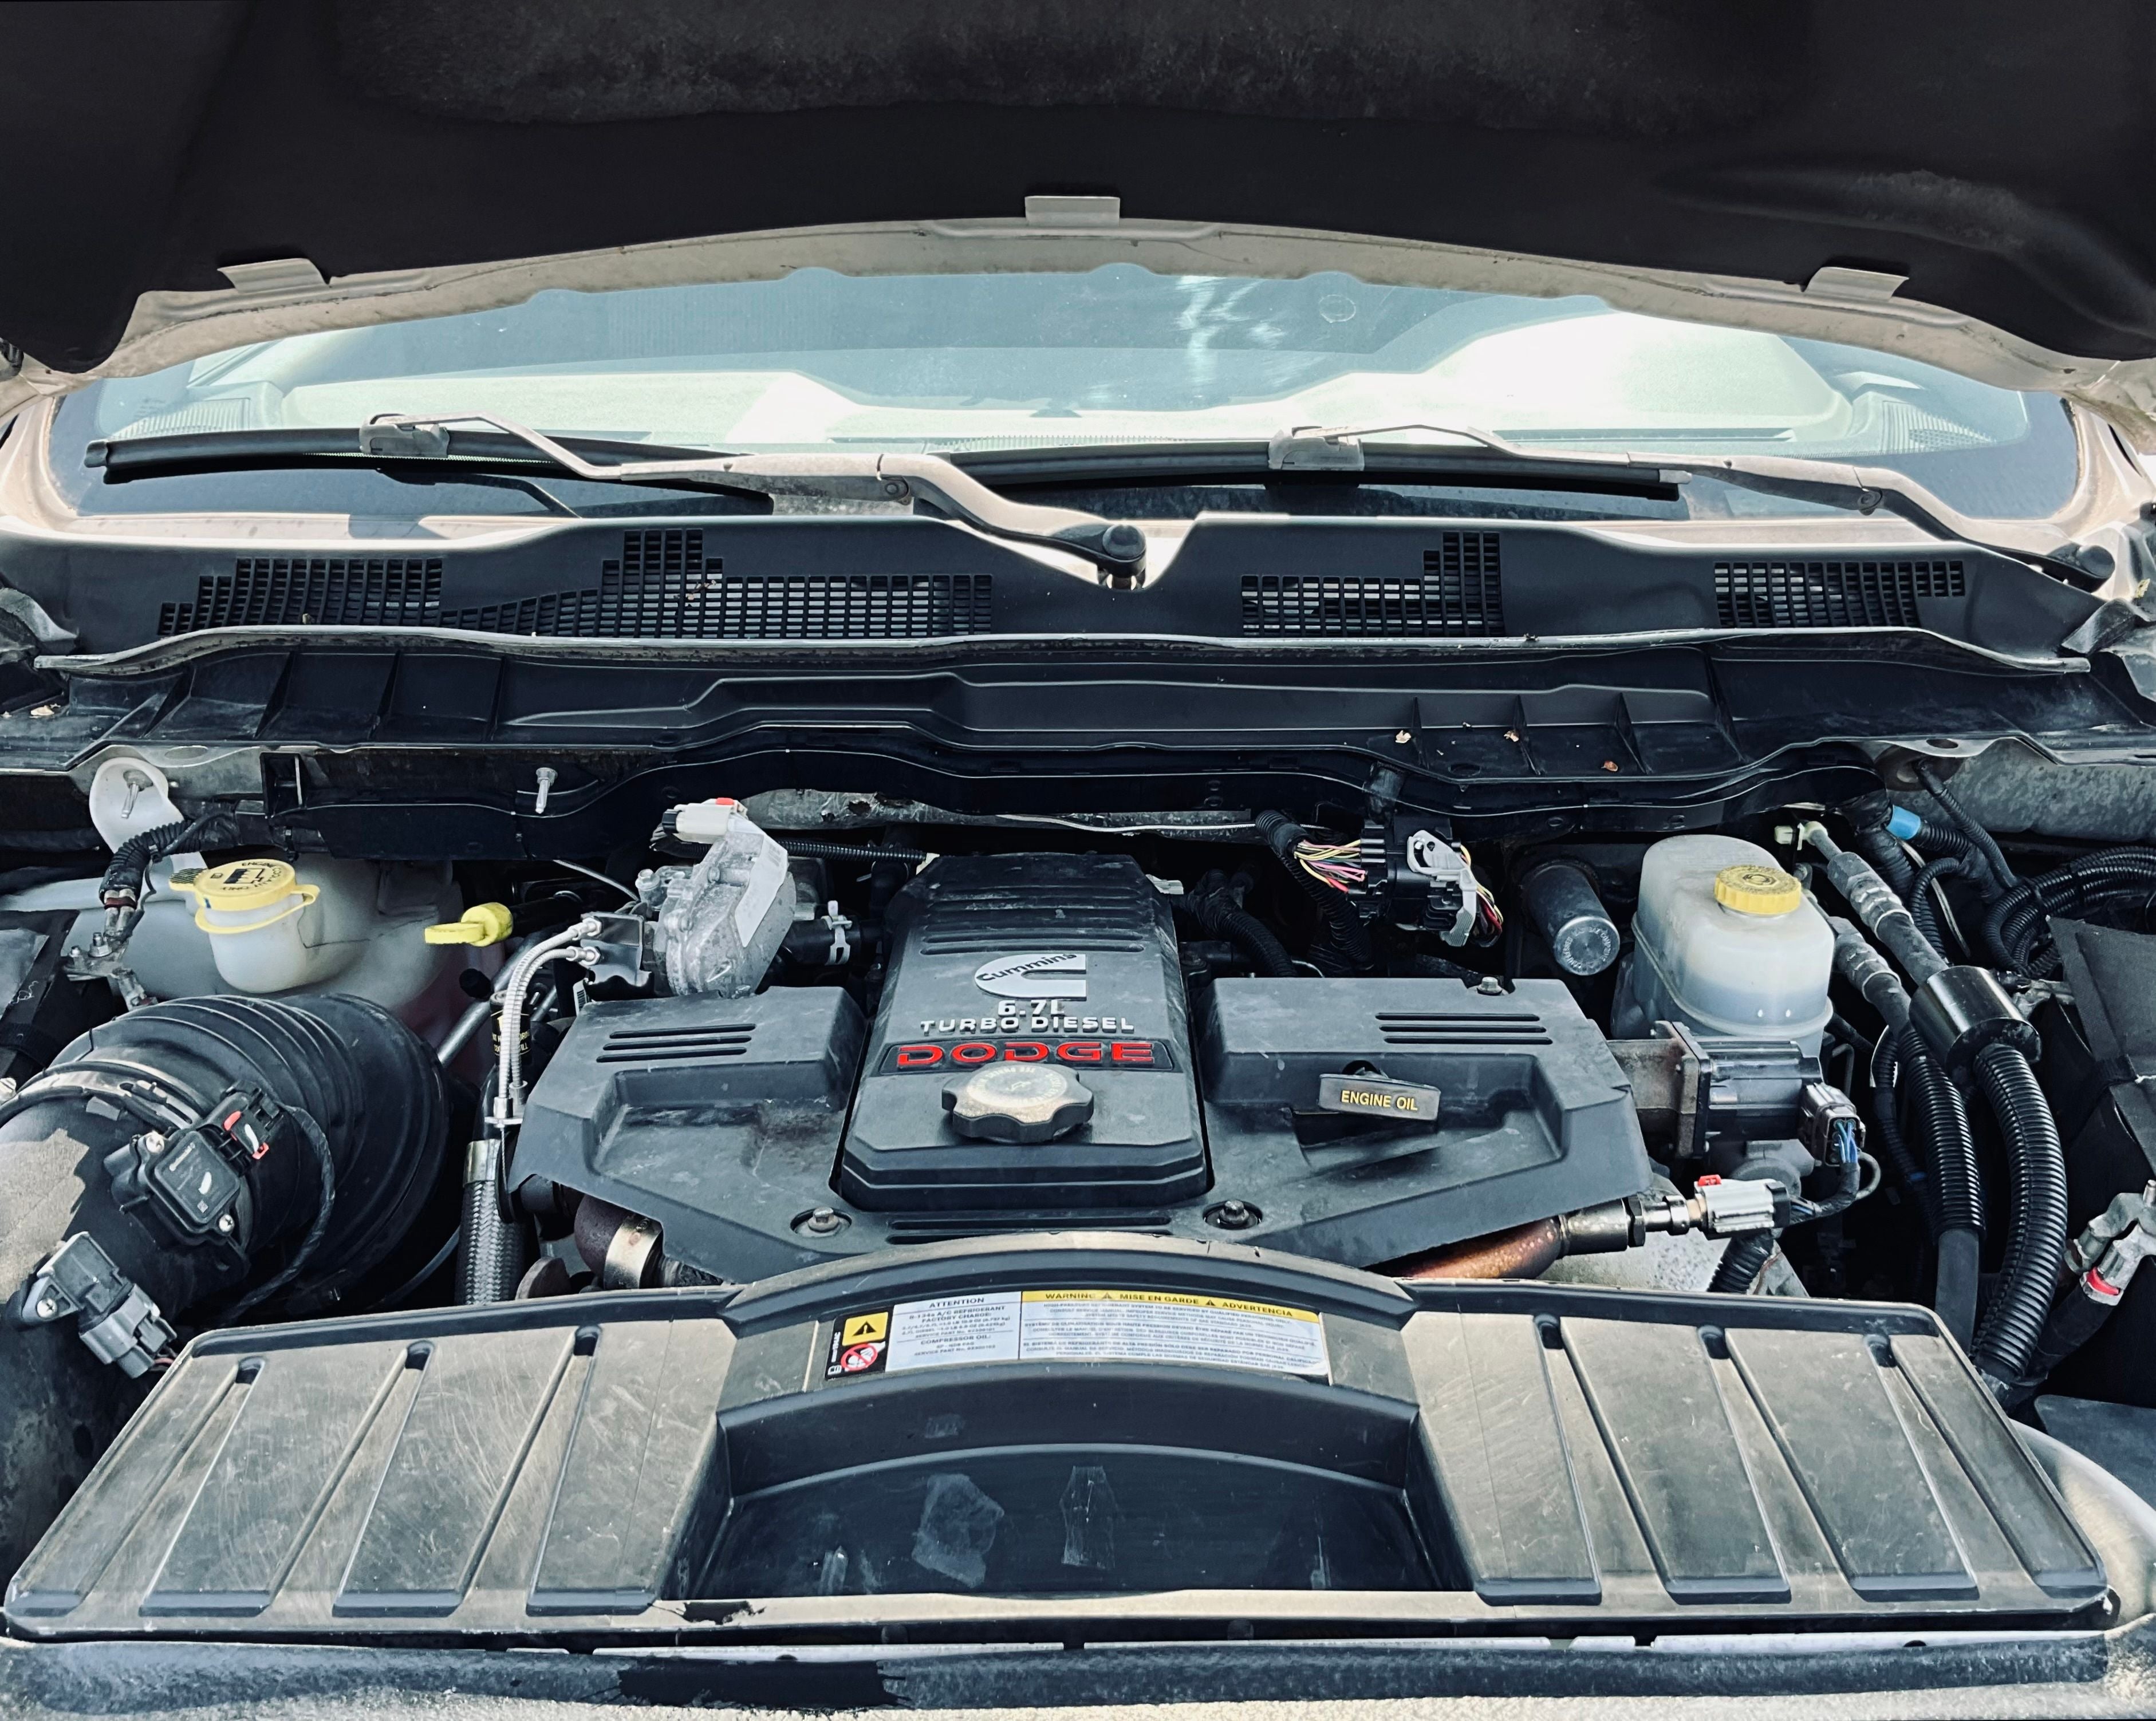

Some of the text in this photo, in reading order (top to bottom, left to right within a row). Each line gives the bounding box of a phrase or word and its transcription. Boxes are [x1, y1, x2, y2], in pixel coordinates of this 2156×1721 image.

[976, 953, 1077, 981] Cummins
[998, 1000, 1065, 1017] 6.7L
[921, 1016, 1134, 1035] TURBO DIESEL
[897, 1042, 1154, 1067] DODGE
[1341, 1090, 1418, 1111] ENGINE OIL
[929, 1297, 984, 1308] ATTENTION
[953, 1305, 1006, 1314] REFRIGERANT
[1164, 1296, 1199, 1304] GARDE
[1222, 1301, 1292, 1317] ADVERTENCIA
[921, 1336, 973, 1345] COMPRESSOR
